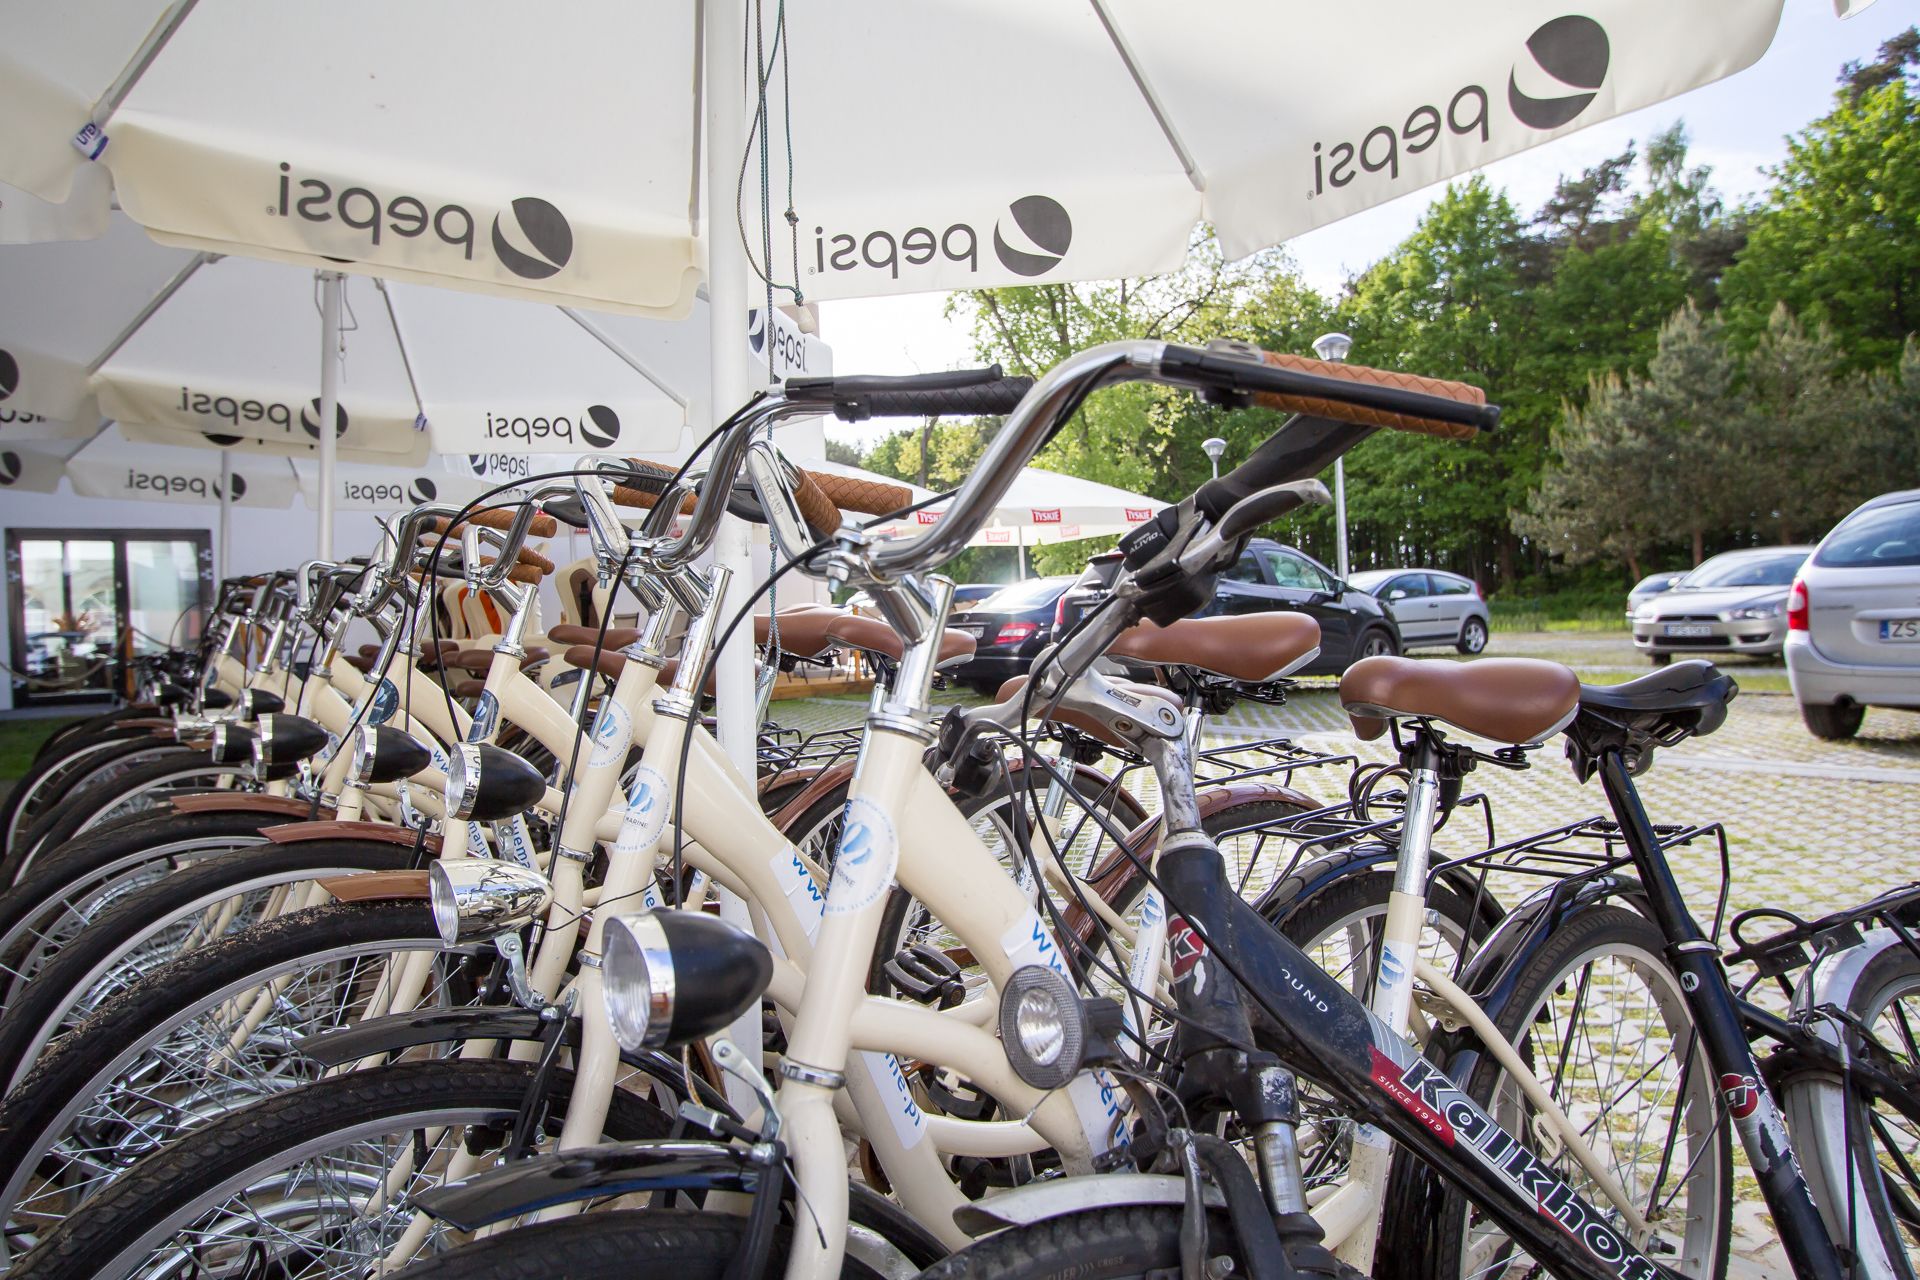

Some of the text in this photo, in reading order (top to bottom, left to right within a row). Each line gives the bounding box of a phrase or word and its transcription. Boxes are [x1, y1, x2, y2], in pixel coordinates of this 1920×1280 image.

[489, 454, 530, 477] pepsi
[1033, 510, 1061, 522] TYSKIE
[1682, 974, 1696, 989] M
[1378, 1075, 1443, 1132] SINCE 1919
